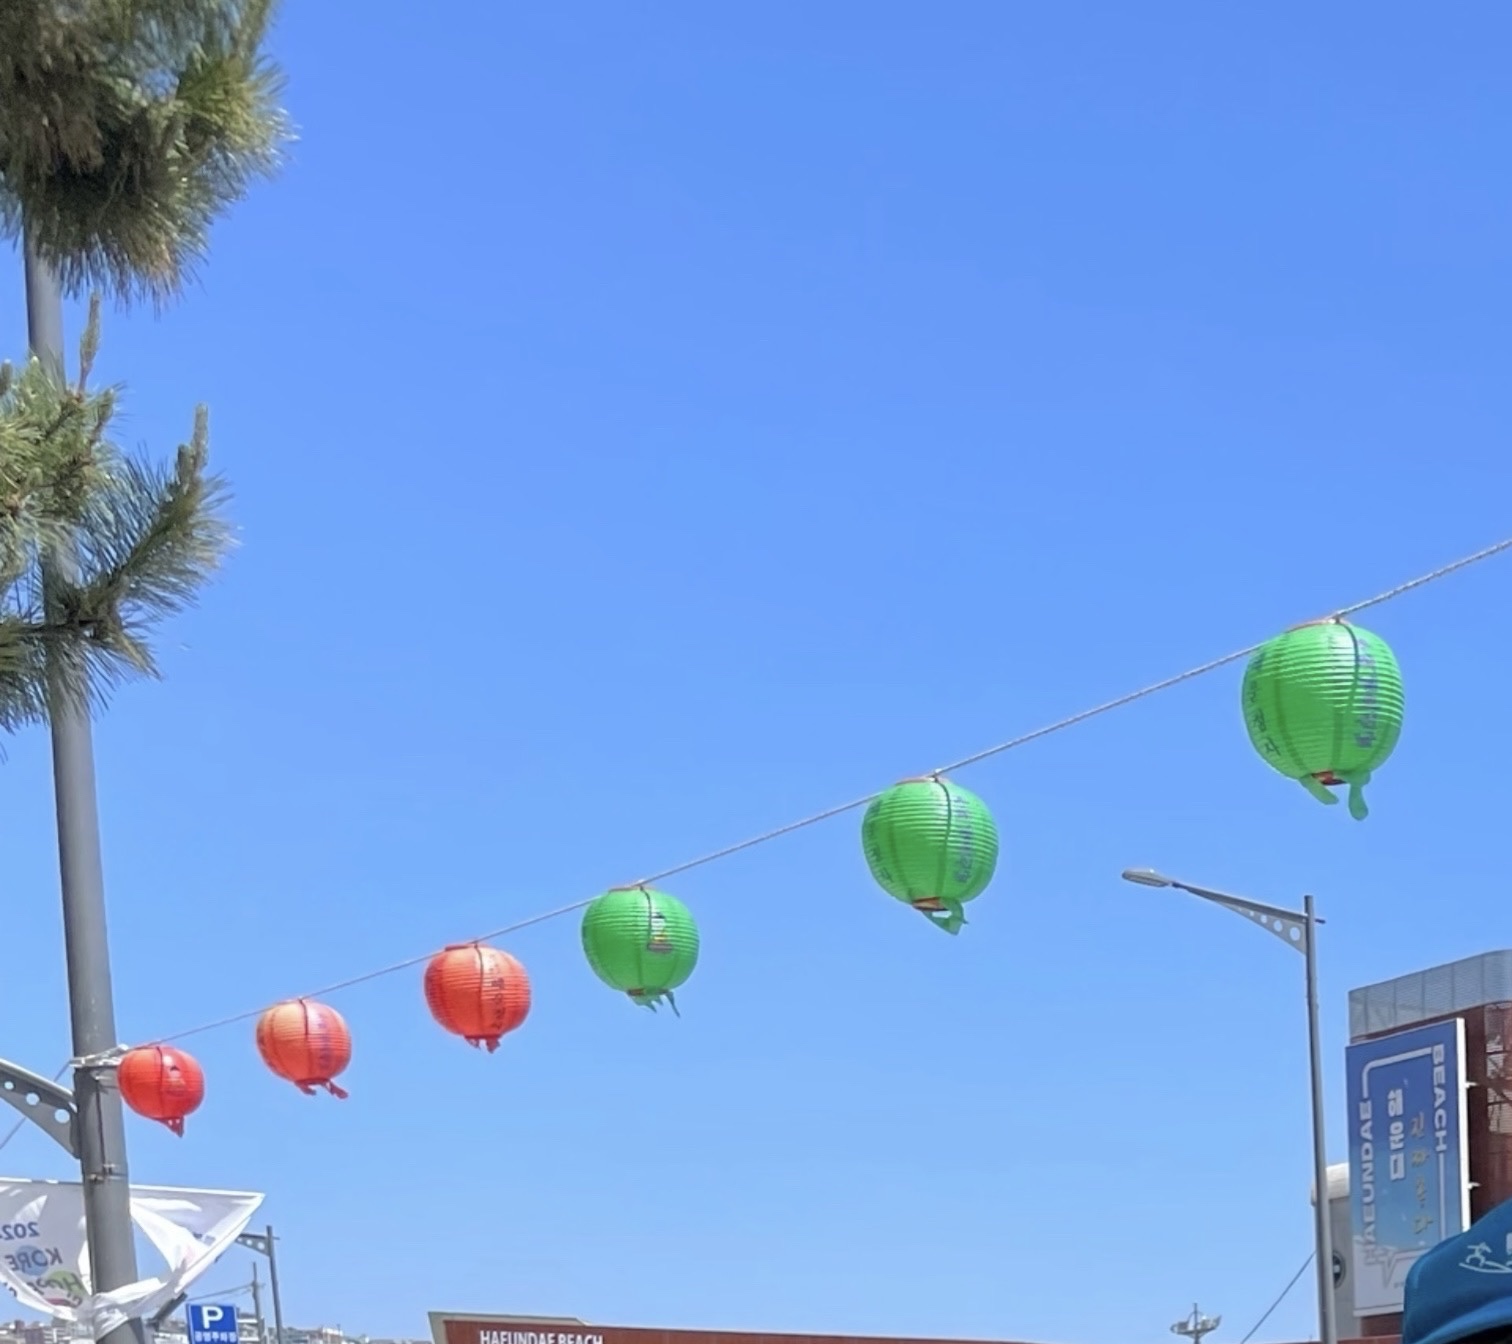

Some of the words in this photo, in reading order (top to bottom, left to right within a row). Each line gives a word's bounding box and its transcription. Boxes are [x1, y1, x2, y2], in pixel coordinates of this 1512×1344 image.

[1387, 1088, 1406, 1182] 해운대
[1432, 1043, 1448, 1152] BEACH
[202, 1305, 224, 1330] P
